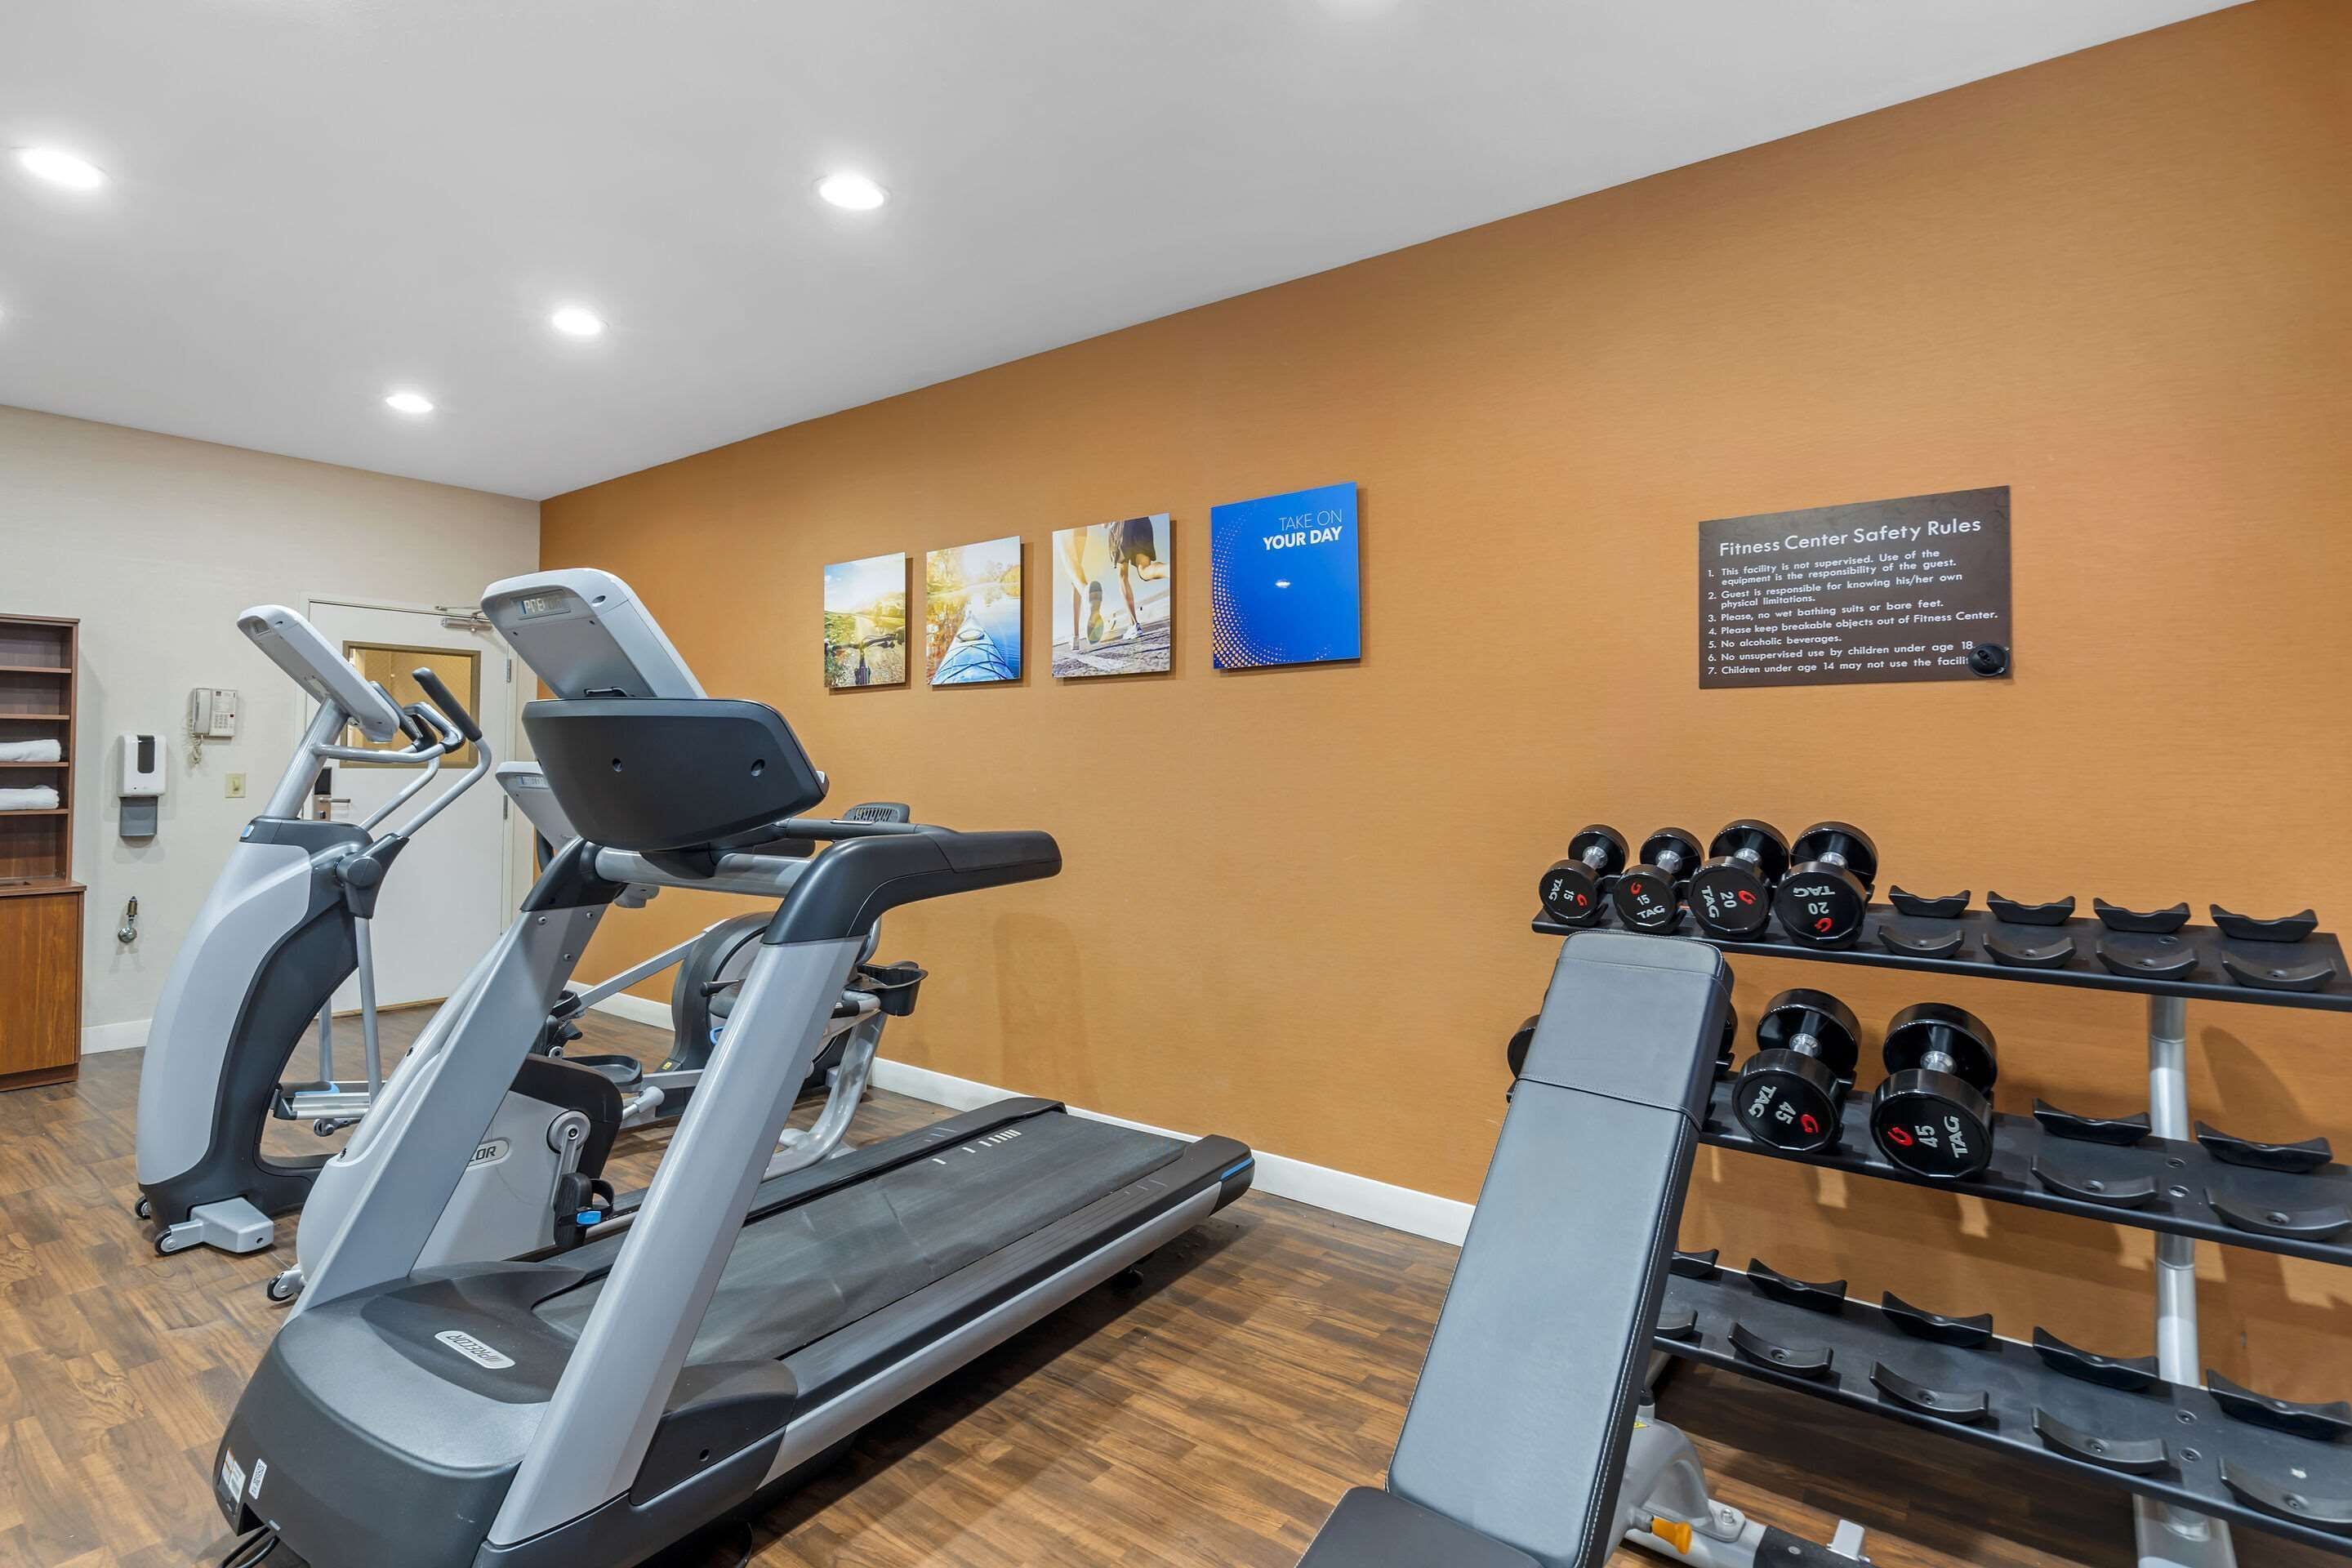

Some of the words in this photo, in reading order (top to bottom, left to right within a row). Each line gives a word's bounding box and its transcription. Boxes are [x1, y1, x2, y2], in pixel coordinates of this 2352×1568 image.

[1278, 514, 1313, 531] TAKE
[1317, 509, 1342, 526] ON
[1263, 532, 1307, 550] YOUR
[1310, 526, 1343, 544] DAY
[1719, 541, 1780, 556] Fitness
[1784, 534, 1848, 549] Center
[1854, 525, 1921, 543] Safety
[1928, 519, 1981, 536] Rules
[1722, 568, 1738, 576] This
[1744, 564, 1776, 574] facility
[1794, 562, 1810, 570] not
[1815, 555, 1873, 568] supervised.
[1879, 554, 1899, 562] Use
[1904, 550, 1916, 559] of
[1922, 550, 1940, 558] the
[1722, 575, 1771, 586] equipment
[1808, 565, 1877, 578] responsibility
[1882, 564, 1894, 572] of
[1900, 562, 1917, 570] the
[1923, 559, 1956, 570] guest.
[1722, 590, 1749, 599] Guest
[1766, 584, 1821, 595] responsible
[1847, 579, 1890, 589] knowing
[1896, 575, 1934, 586] his/her
[1708, 614, 1717, 622] 3.
[1722, 613, 1754, 621] Please,
[1797, 608, 1836, 616] bathing
[1842, 605, 1864, 613] suits
[1918, 600, 1944, 608] feet.
[1722, 598, 1757, 610] physical
[1763, 596, 1815, 604] limitations.
[1722, 626, 1751, 635] Please
[1755, 625, 1777, 633] keep
[1782, 621, 1832, 630] breakable
[1836, 618, 1873, 629] objects
[1899, 616, 1909, 624] of
[1914, 614, 1952, 622] Fitness
[1956, 612, 1998, 621] Center.
[1740, 638, 1782, 647] alcoholic
[1787, 635, 1842, 644] beverages.
[1740, 649, 1802, 661] unsupervised
[1830, 648, 1842, 657] by
[1848, 646, 1889, 655] children
[1895, 644, 1926, 653] under
[1931, 644, 1953, 653] age
[1722, 666, 1760, 674] Children
[1840, 662, 1861, 670] may
[1913, 658, 1931, 666] the
[1548, 878, 1563, 902] TAG
[1563, 889, 1575, 902] 15
[1637, 893, 1650, 906] 15
[1720, 891, 1737, 908] 20
[1793, 885, 1836, 898] TAG
[1637, 905, 1665, 919] TAG
[1701, 885, 1720, 918] TAG
[1807, 902, 1830, 915] 20
[1748, 1085, 1777, 1118] TAG
[1775, 1101, 1797, 1125] 45
[1914, 1125, 1938, 1147] 45
[1944, 1116, 1968, 1158] TAG
[470, 1146, 497, 1161] OR
[446, 1334, 492, 1361] PRECOR
